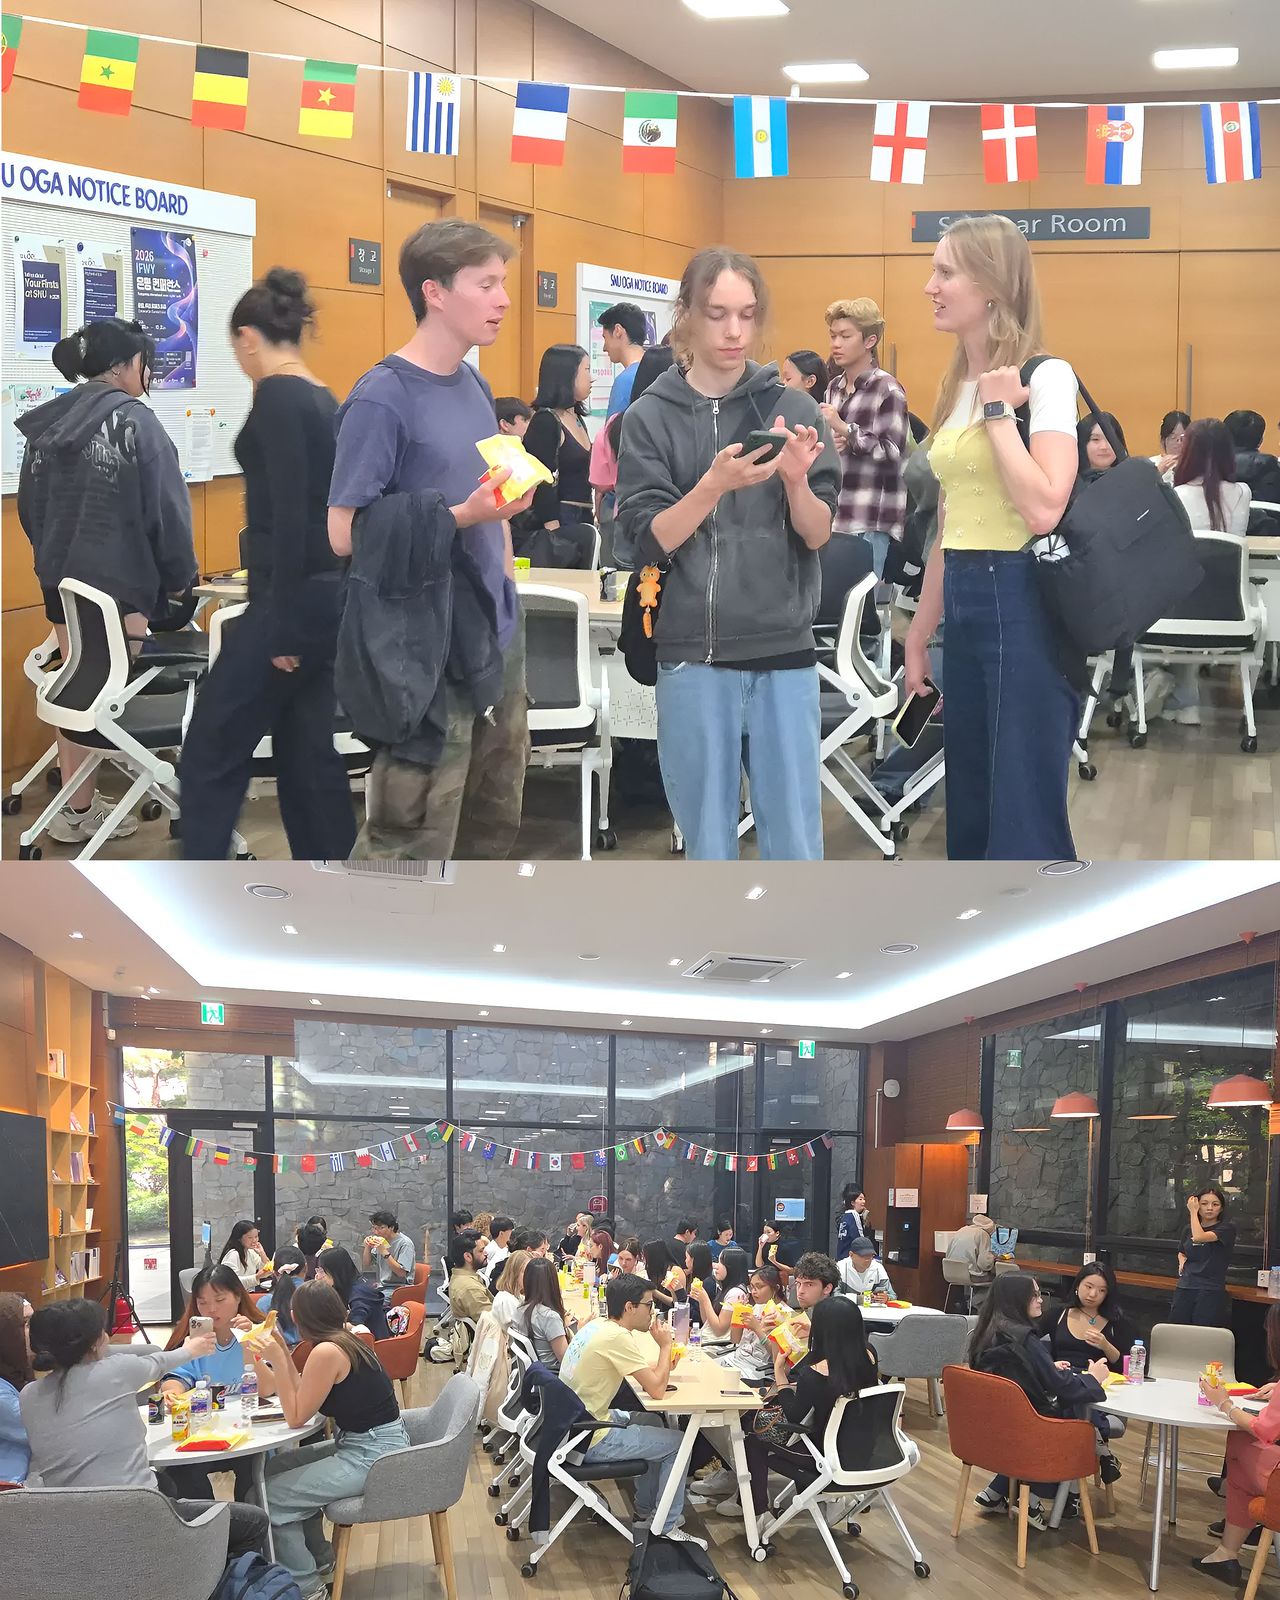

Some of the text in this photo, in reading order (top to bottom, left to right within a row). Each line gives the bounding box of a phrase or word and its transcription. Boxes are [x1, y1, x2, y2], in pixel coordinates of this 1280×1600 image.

[20, 165, 64, 196] OGA
[68, 174, 131, 207] NOTICE
[135, 186, 188, 216] BOARD
[1051, 214, 1127, 234] Room
[135, 249, 154, 262] 2026
[135, 262, 155, 275] IFWY
[610, 273, 669, 295] SNU OGA NOTICE BOARD
